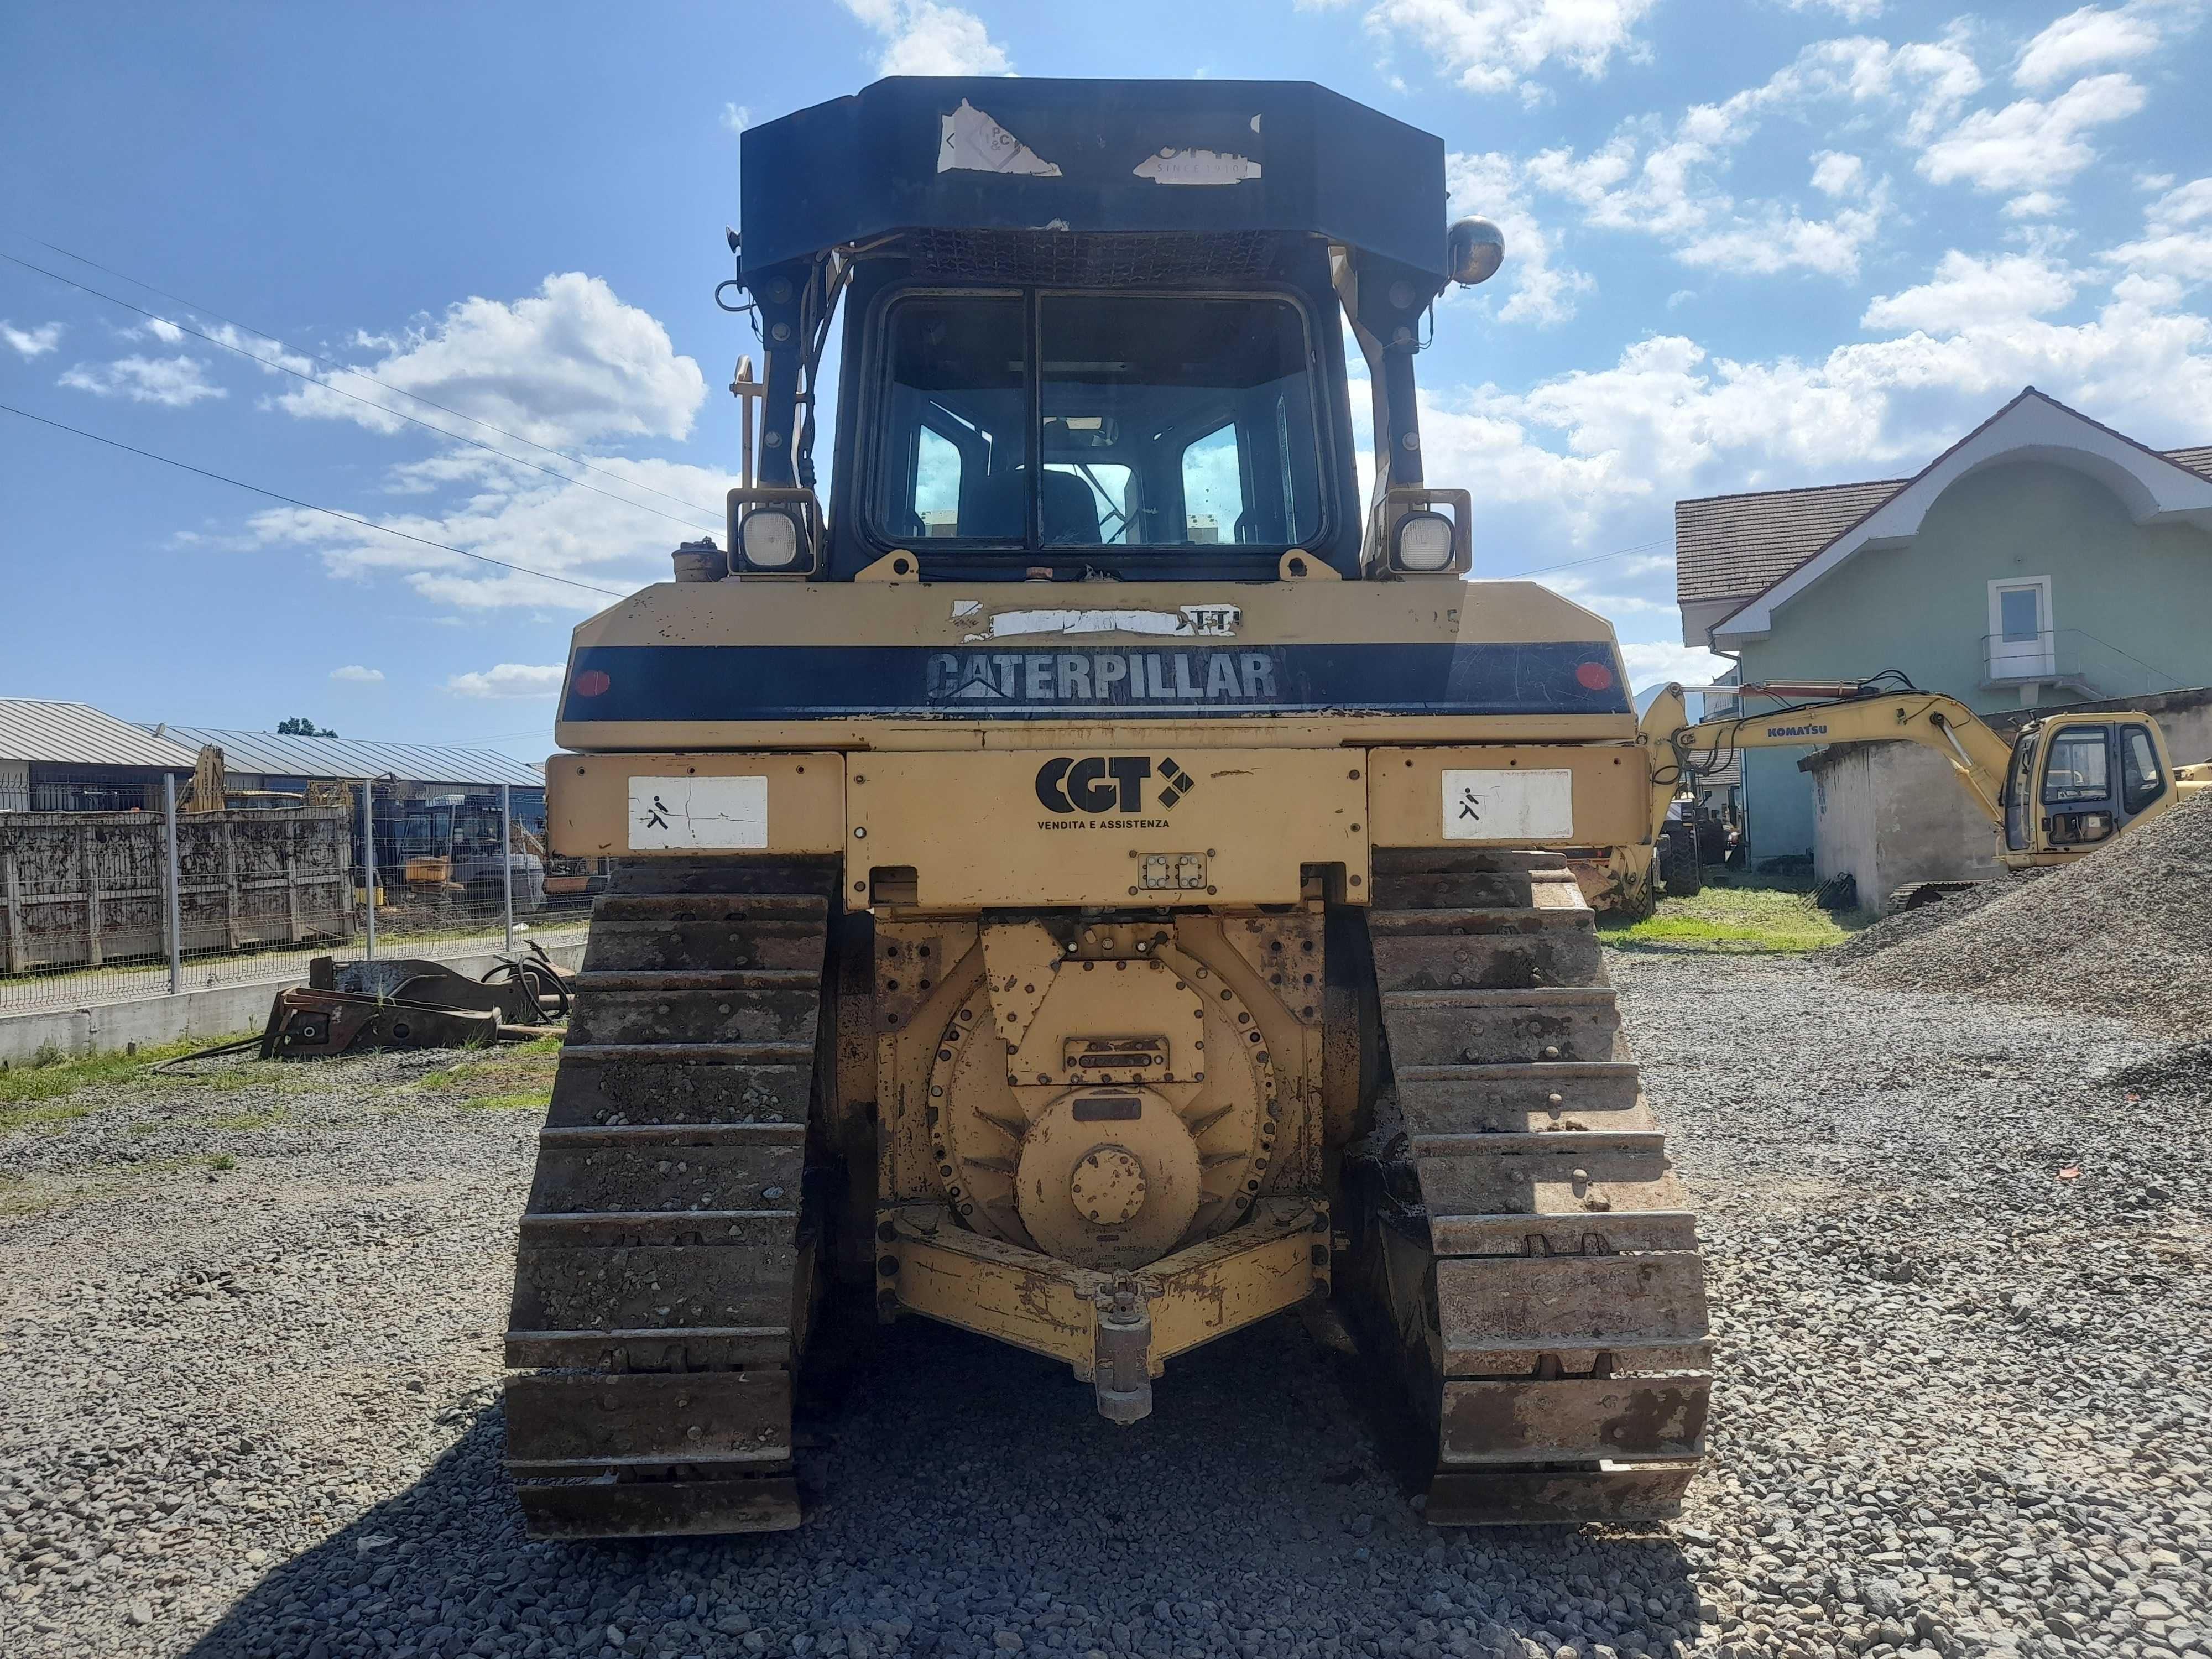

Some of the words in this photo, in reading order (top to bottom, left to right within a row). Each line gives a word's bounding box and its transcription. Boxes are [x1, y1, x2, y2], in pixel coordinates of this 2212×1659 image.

[1157, 164, 1199, 173] SINCE
[1207, 164, 1238, 173] 1910
[927, 653, 1278, 699] CATERPILLAR
[1768, 724, 1827, 737] KOMATSU
[1035, 757, 1151, 813] CGT
[1037, 821, 1086, 830] VENDITA
[1089, 821, 1096, 829] E
[1100, 820, 1170, 828] ASSISTENZA
